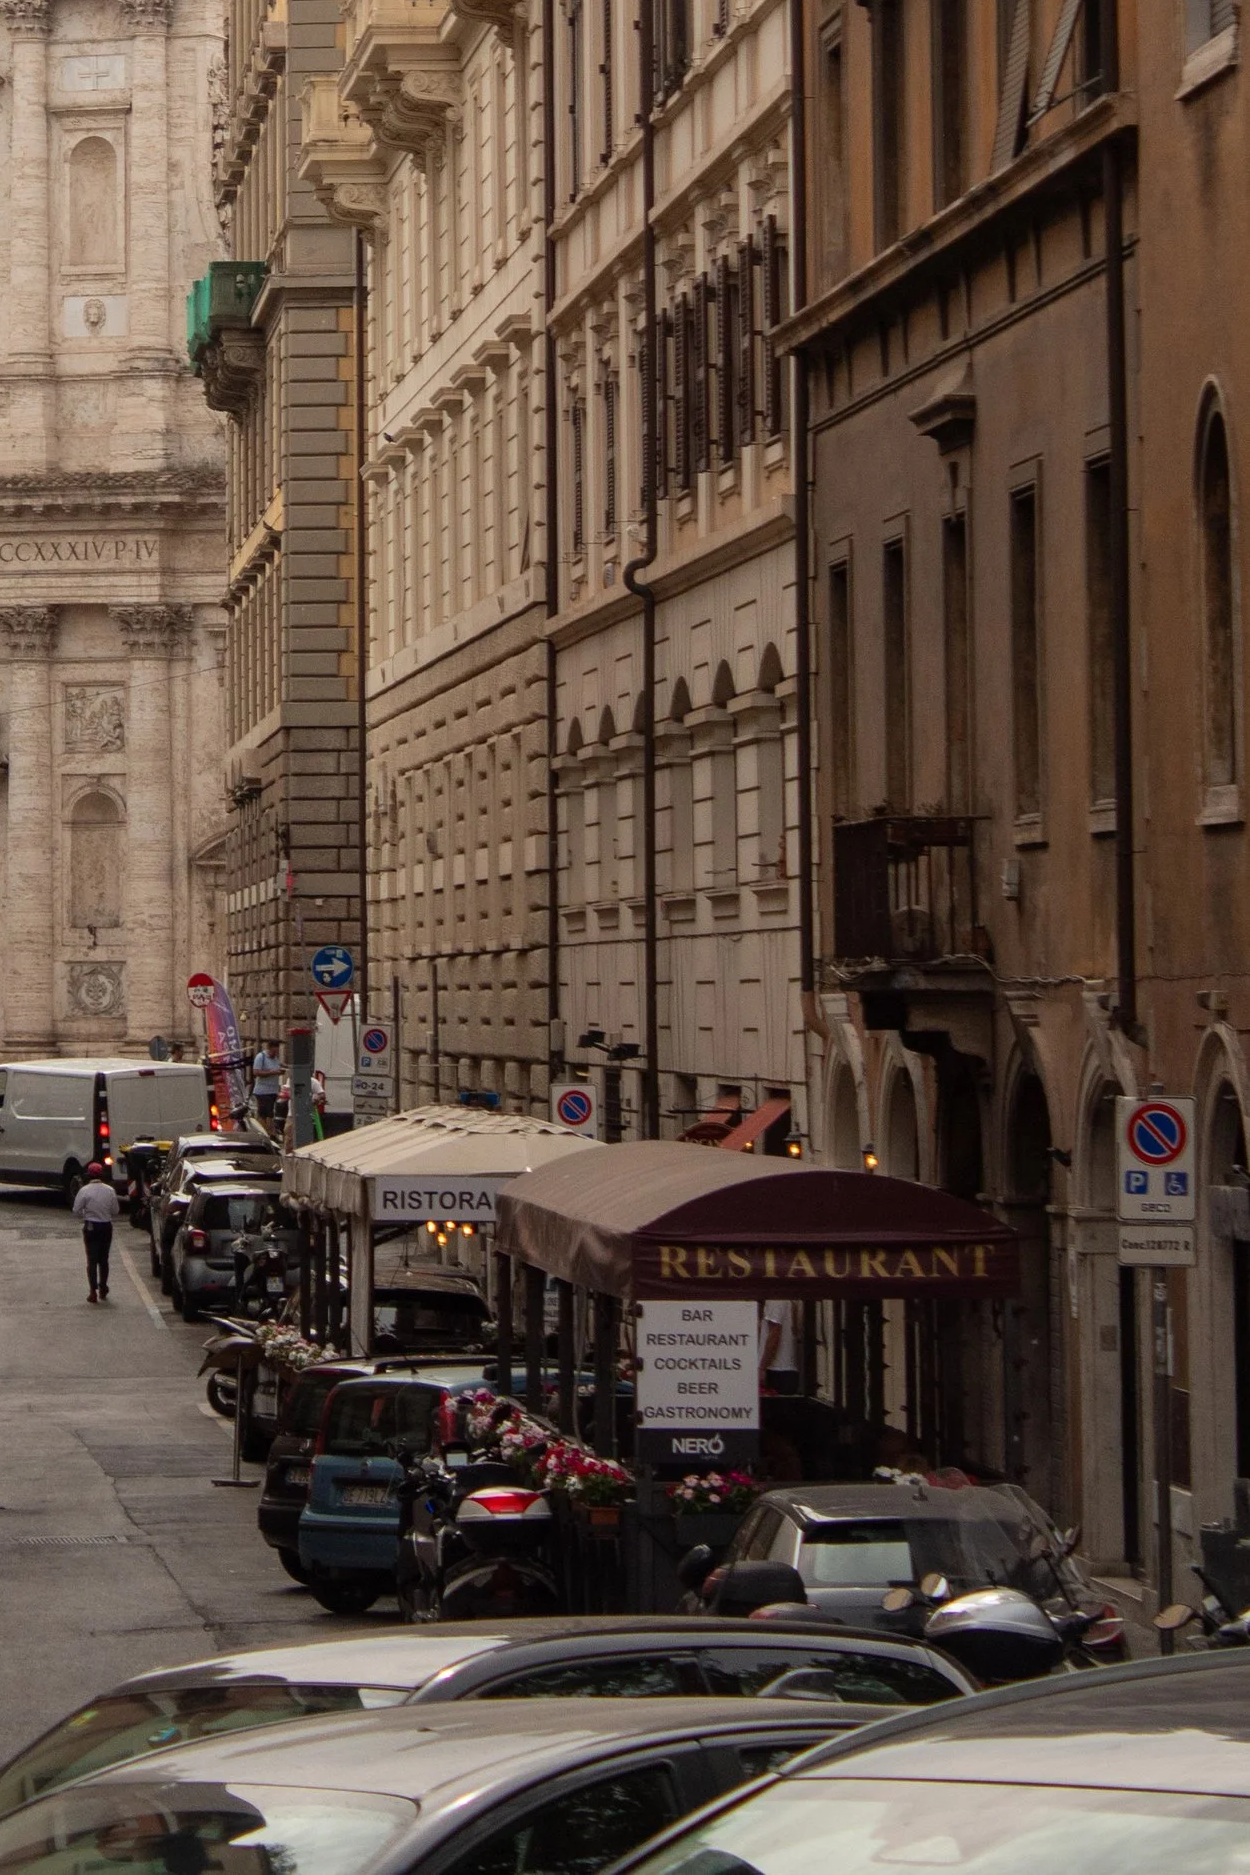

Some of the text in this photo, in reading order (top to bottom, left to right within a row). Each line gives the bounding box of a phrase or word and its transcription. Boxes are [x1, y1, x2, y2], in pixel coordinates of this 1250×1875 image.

[382, 1190, 492, 1210] RISTORA
[658, 1244, 996, 1278] RESTAURANT
[682, 1309, 713, 1322] BAR
[646, 1333, 749, 1346] RESTAURANT
[654, 1358, 741, 1370] COCKTAILS
[677, 1382, 719, 1394] BEER
[644, 1406, 752, 1419] GASTRONOMY
